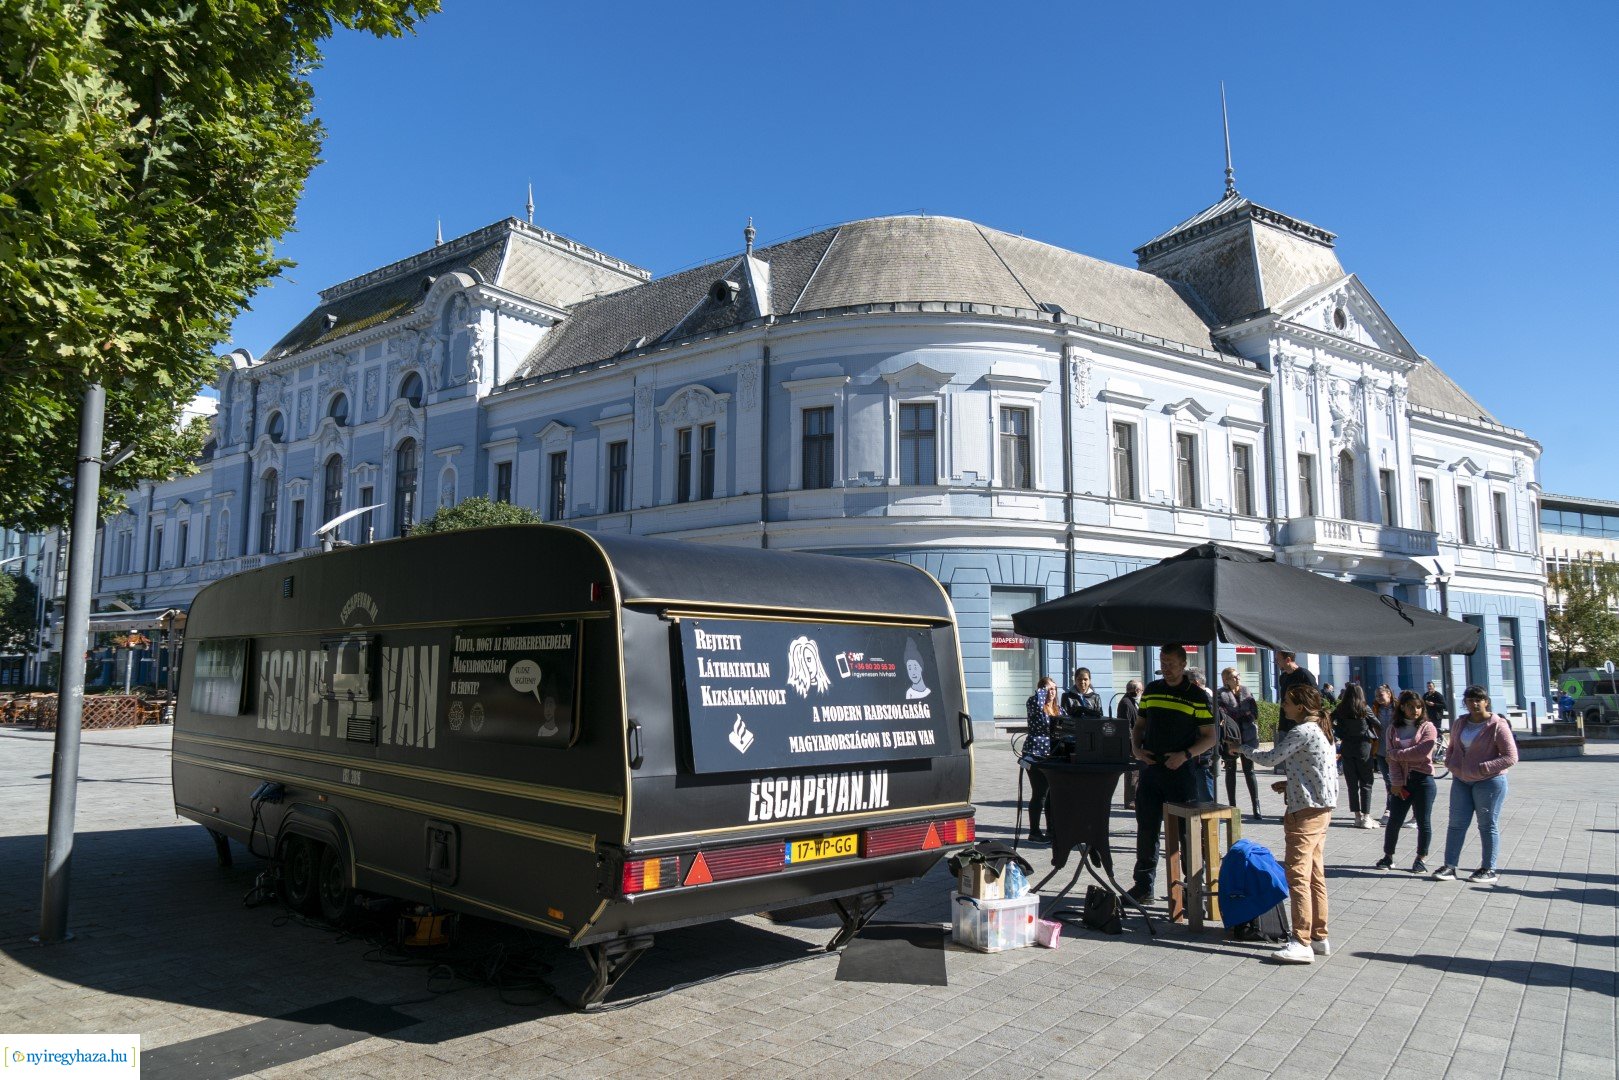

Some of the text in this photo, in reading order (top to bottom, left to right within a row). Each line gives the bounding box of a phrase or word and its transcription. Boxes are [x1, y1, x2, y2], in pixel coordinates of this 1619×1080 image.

[476, 637, 492, 650] HOGY
[493, 637, 501, 650] AZ
[502, 634, 571, 650] EMBERKERESKEDELEM
[694, 629, 741, 650] REJTETT
[452, 656, 507, 673] MAGYARORSZÁGOT
[698, 657, 770, 678] LÁTHATATLAN
[256, 645, 440, 748] ESCAPE VAN
[450, 681, 457, 694] IS
[700, 685, 786, 706] KIZSÁKMÁNYOLT
[813, 703, 930, 722] A MODERN RABSZOLGASÁG
[789, 729, 934, 753] MAGYARORSZÁGON IS JELEN VAN
[748, 770, 889, 821] ESCAPEVAN.NL
[797, 837, 852, 859] 17-WP-GG
